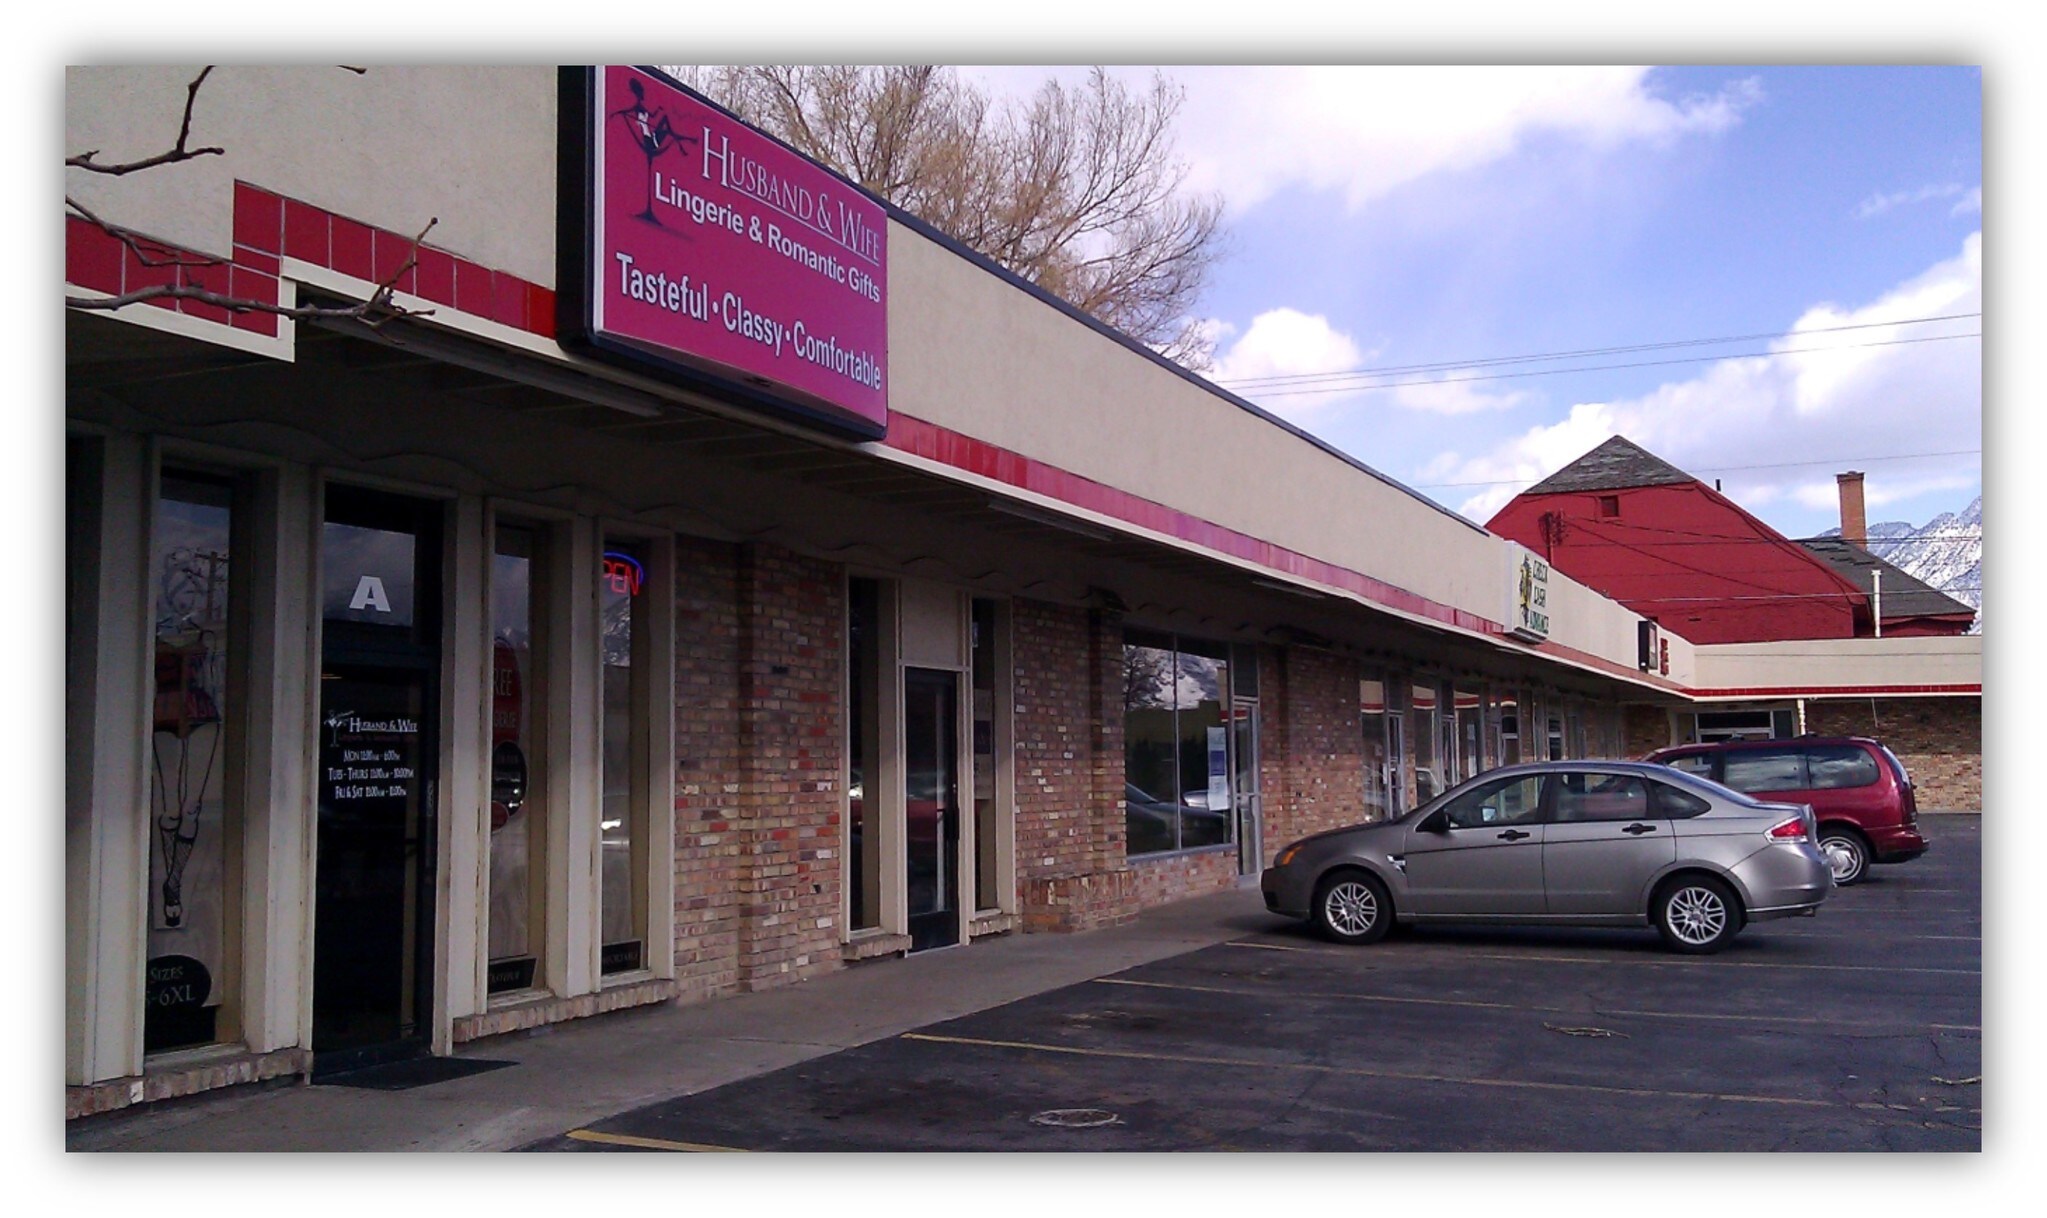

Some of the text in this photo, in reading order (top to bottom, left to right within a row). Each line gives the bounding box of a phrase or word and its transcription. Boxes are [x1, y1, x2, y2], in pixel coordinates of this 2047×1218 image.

[655, 172, 881, 303] Lingerie & Romantic Gifts
[702, 126, 880, 262] HUSBAND & WIFE
[616, 252, 881, 390] Tasteful Classy Comfortable
[349, 575, 391, 612] A
[603, 560, 639, 595] PEN
